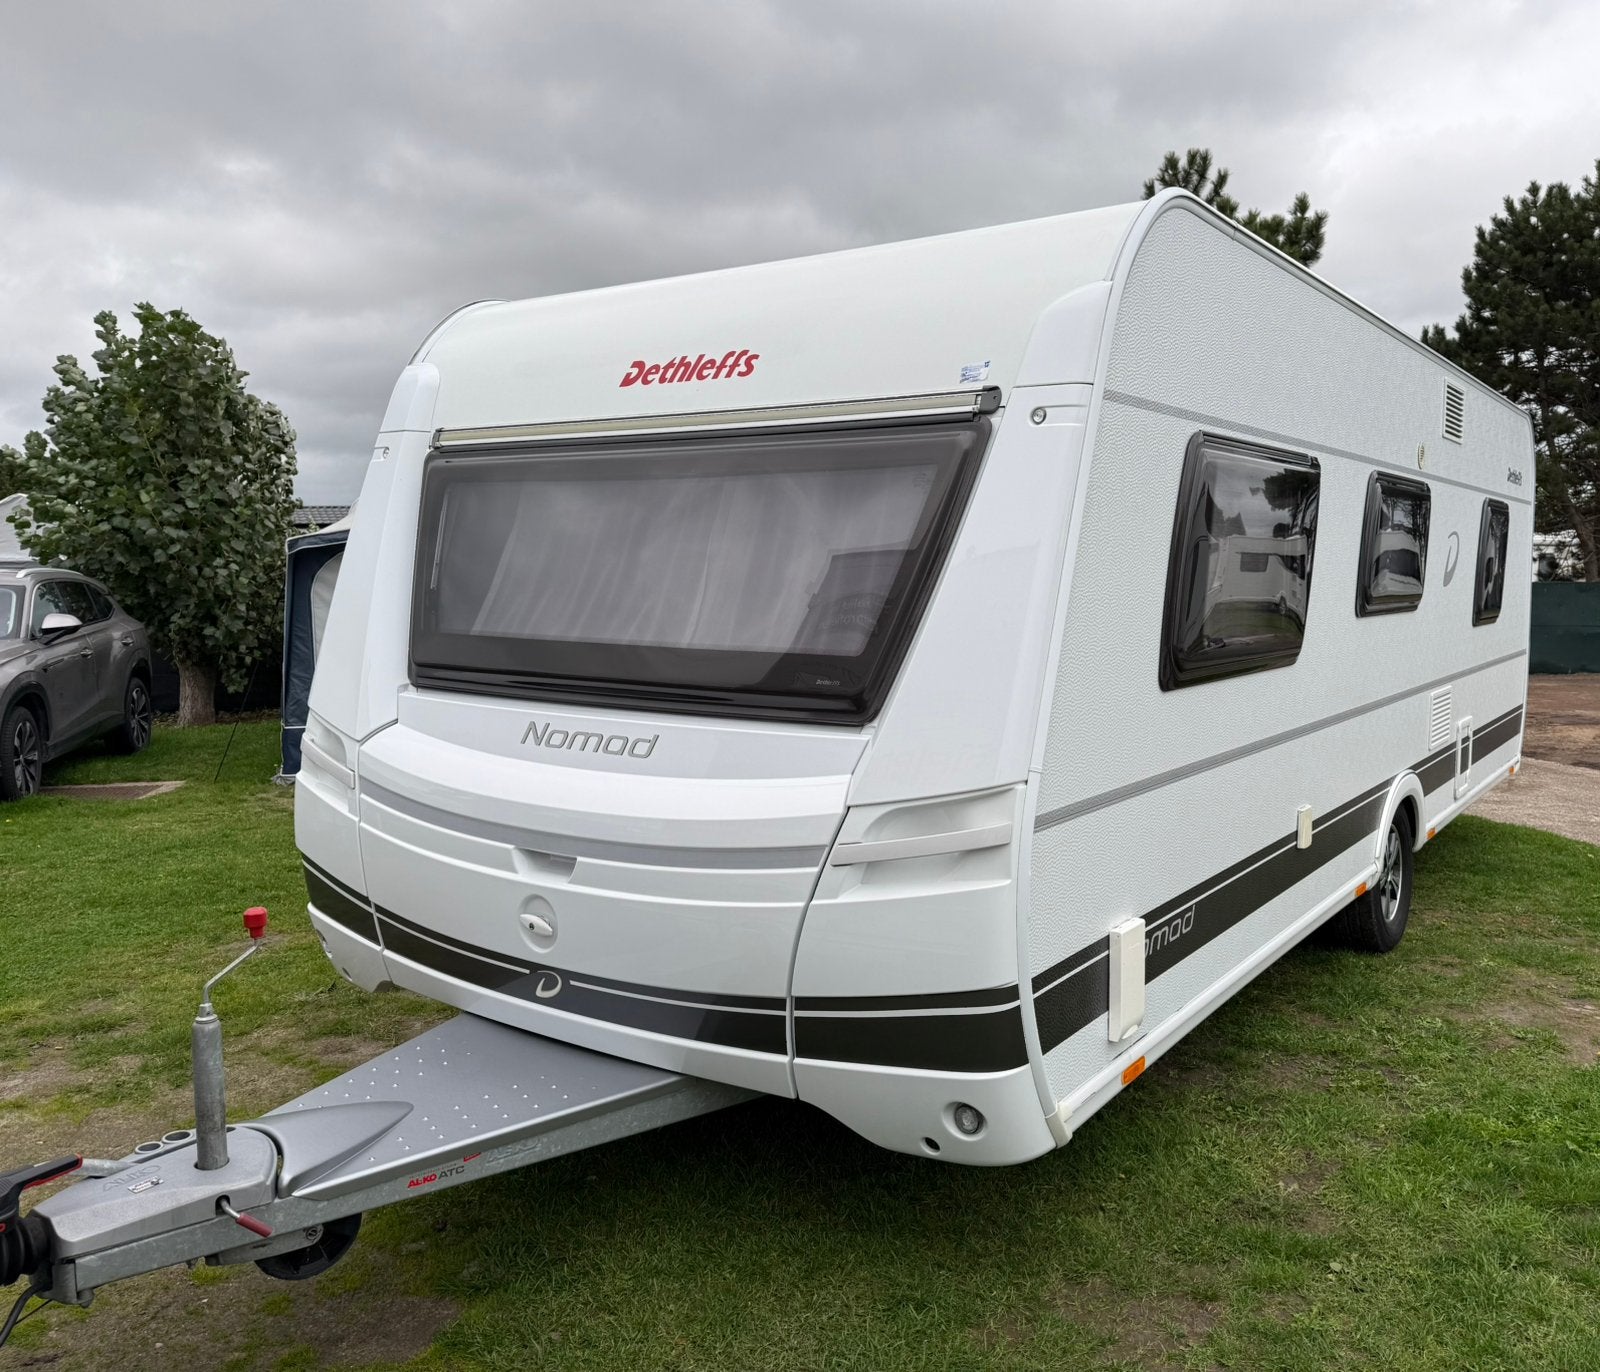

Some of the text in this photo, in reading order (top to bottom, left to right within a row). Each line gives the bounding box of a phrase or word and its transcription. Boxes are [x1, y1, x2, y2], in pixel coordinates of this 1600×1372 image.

[619, 349, 760, 388] Dethleffs
[520, 720, 660, 759] Nomad
[1144, 904, 1196, 958] mad
[438, 1165, 465, 1180] ATC
